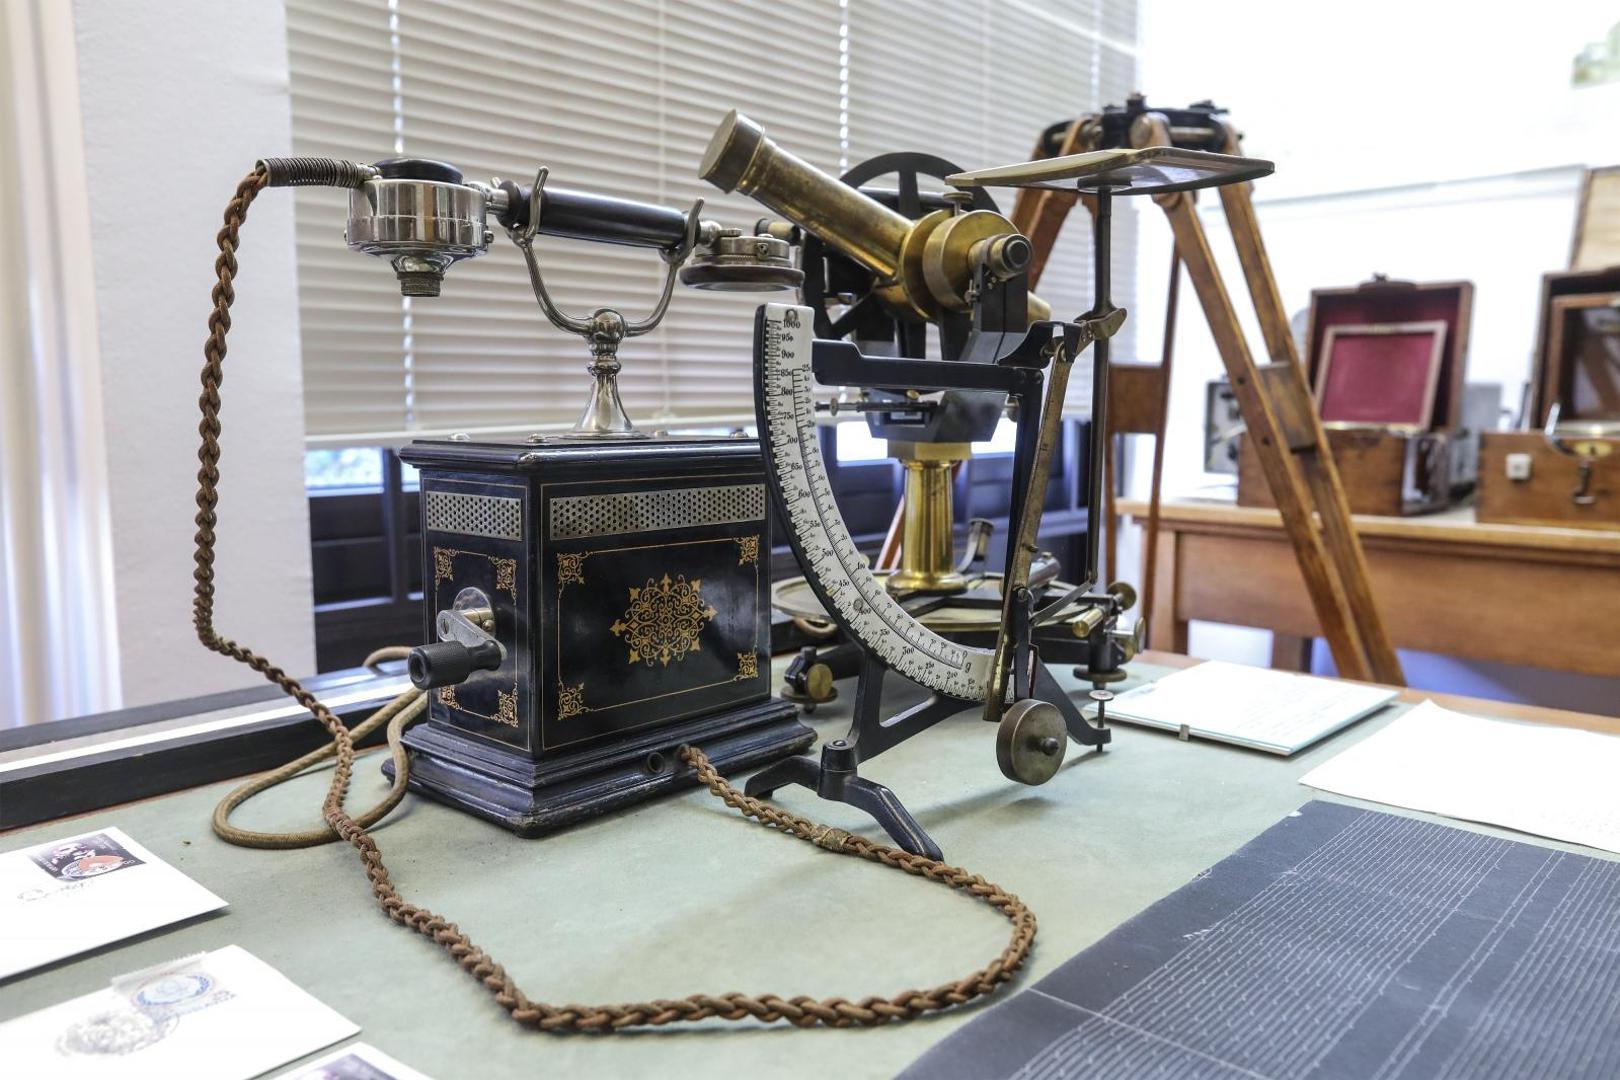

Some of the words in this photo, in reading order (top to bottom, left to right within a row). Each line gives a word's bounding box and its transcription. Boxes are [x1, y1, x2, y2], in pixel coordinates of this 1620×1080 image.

[783, 320, 801, 328] 1000
[781, 333, 794, 342] 950
[781, 350, 795, 358] 900
[781, 368, 792, 377] 850
[781, 387, 793, 396] 800
[784, 412, 794, 420] 750
[787, 434, 798, 444] 700
[798, 488, 810, 498] 600
[822, 548, 834, 556] 500
[902, 646, 915, 655] 300
[946, 671, 958, 679] 200
